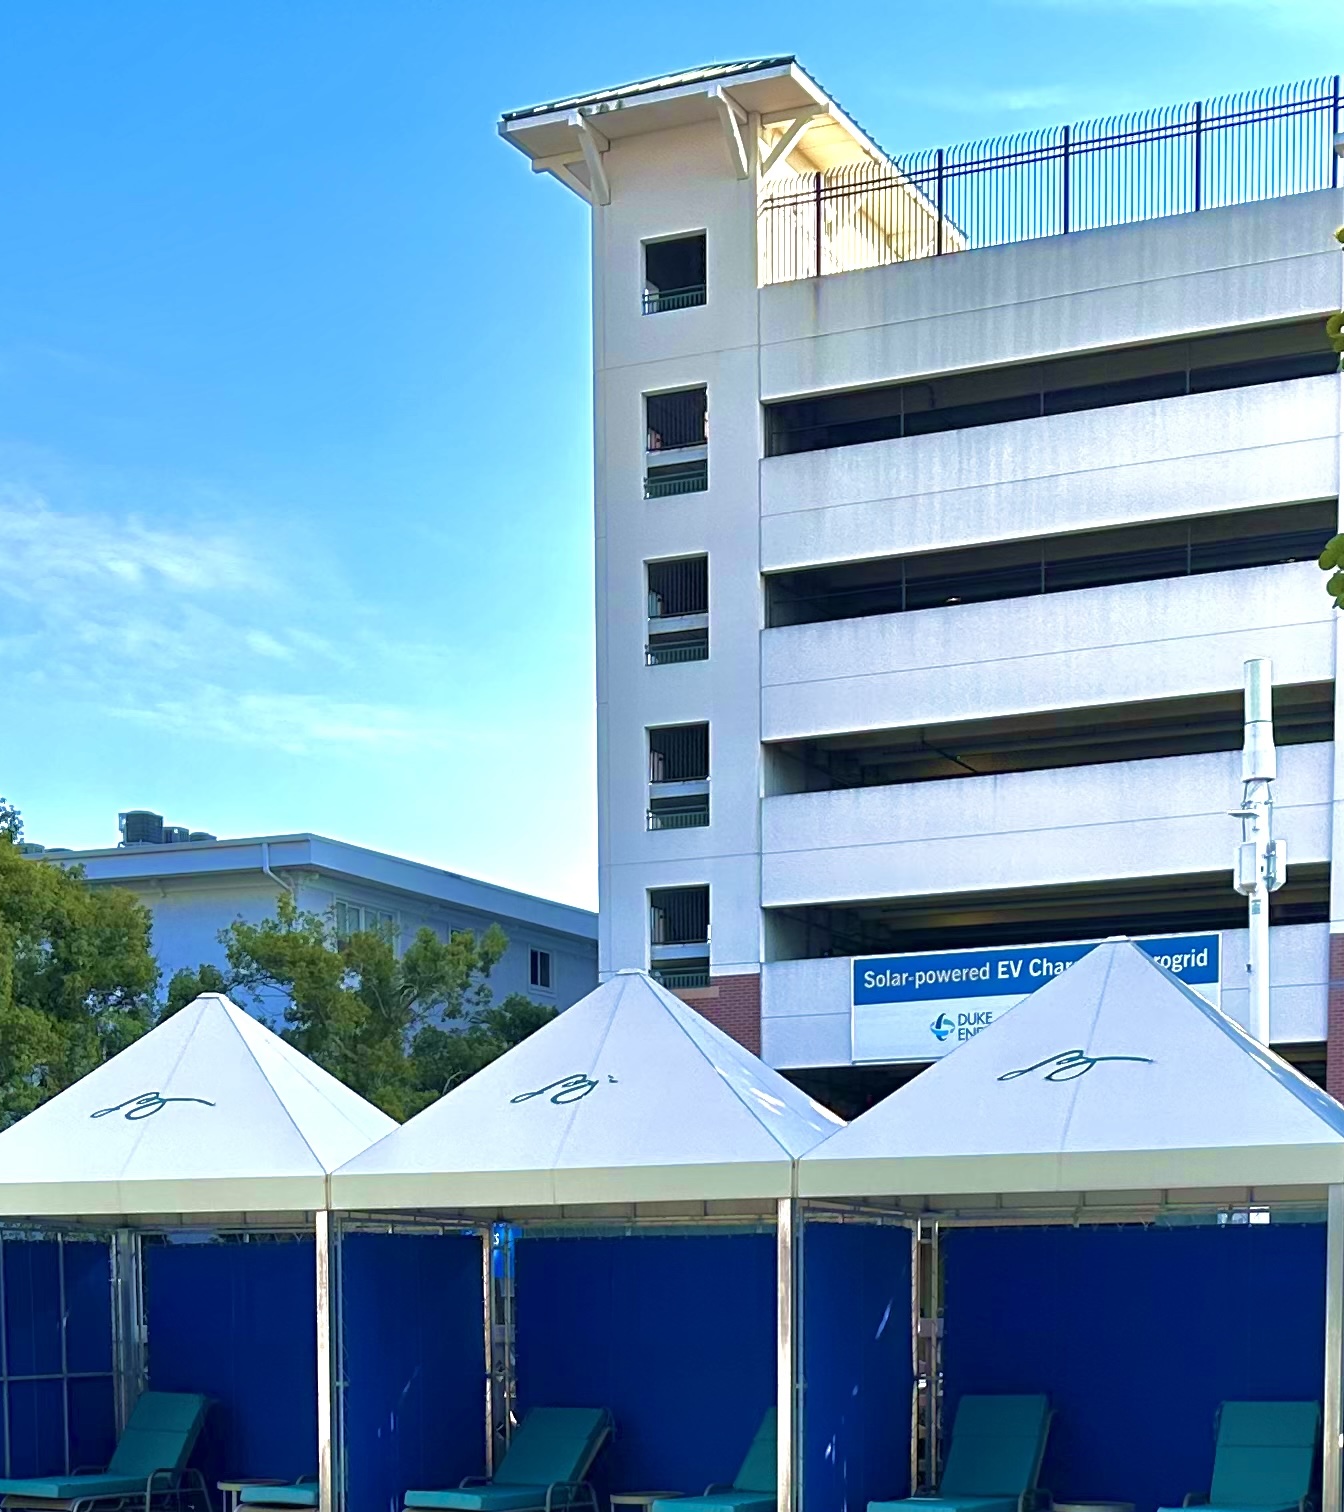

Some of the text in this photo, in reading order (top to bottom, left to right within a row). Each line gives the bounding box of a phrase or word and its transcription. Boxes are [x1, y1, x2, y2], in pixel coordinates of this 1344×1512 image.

[864, 948, 1208, 989] Solar-powered EV Char rogrid
[958, 1012, 992, 1026] DUKE
